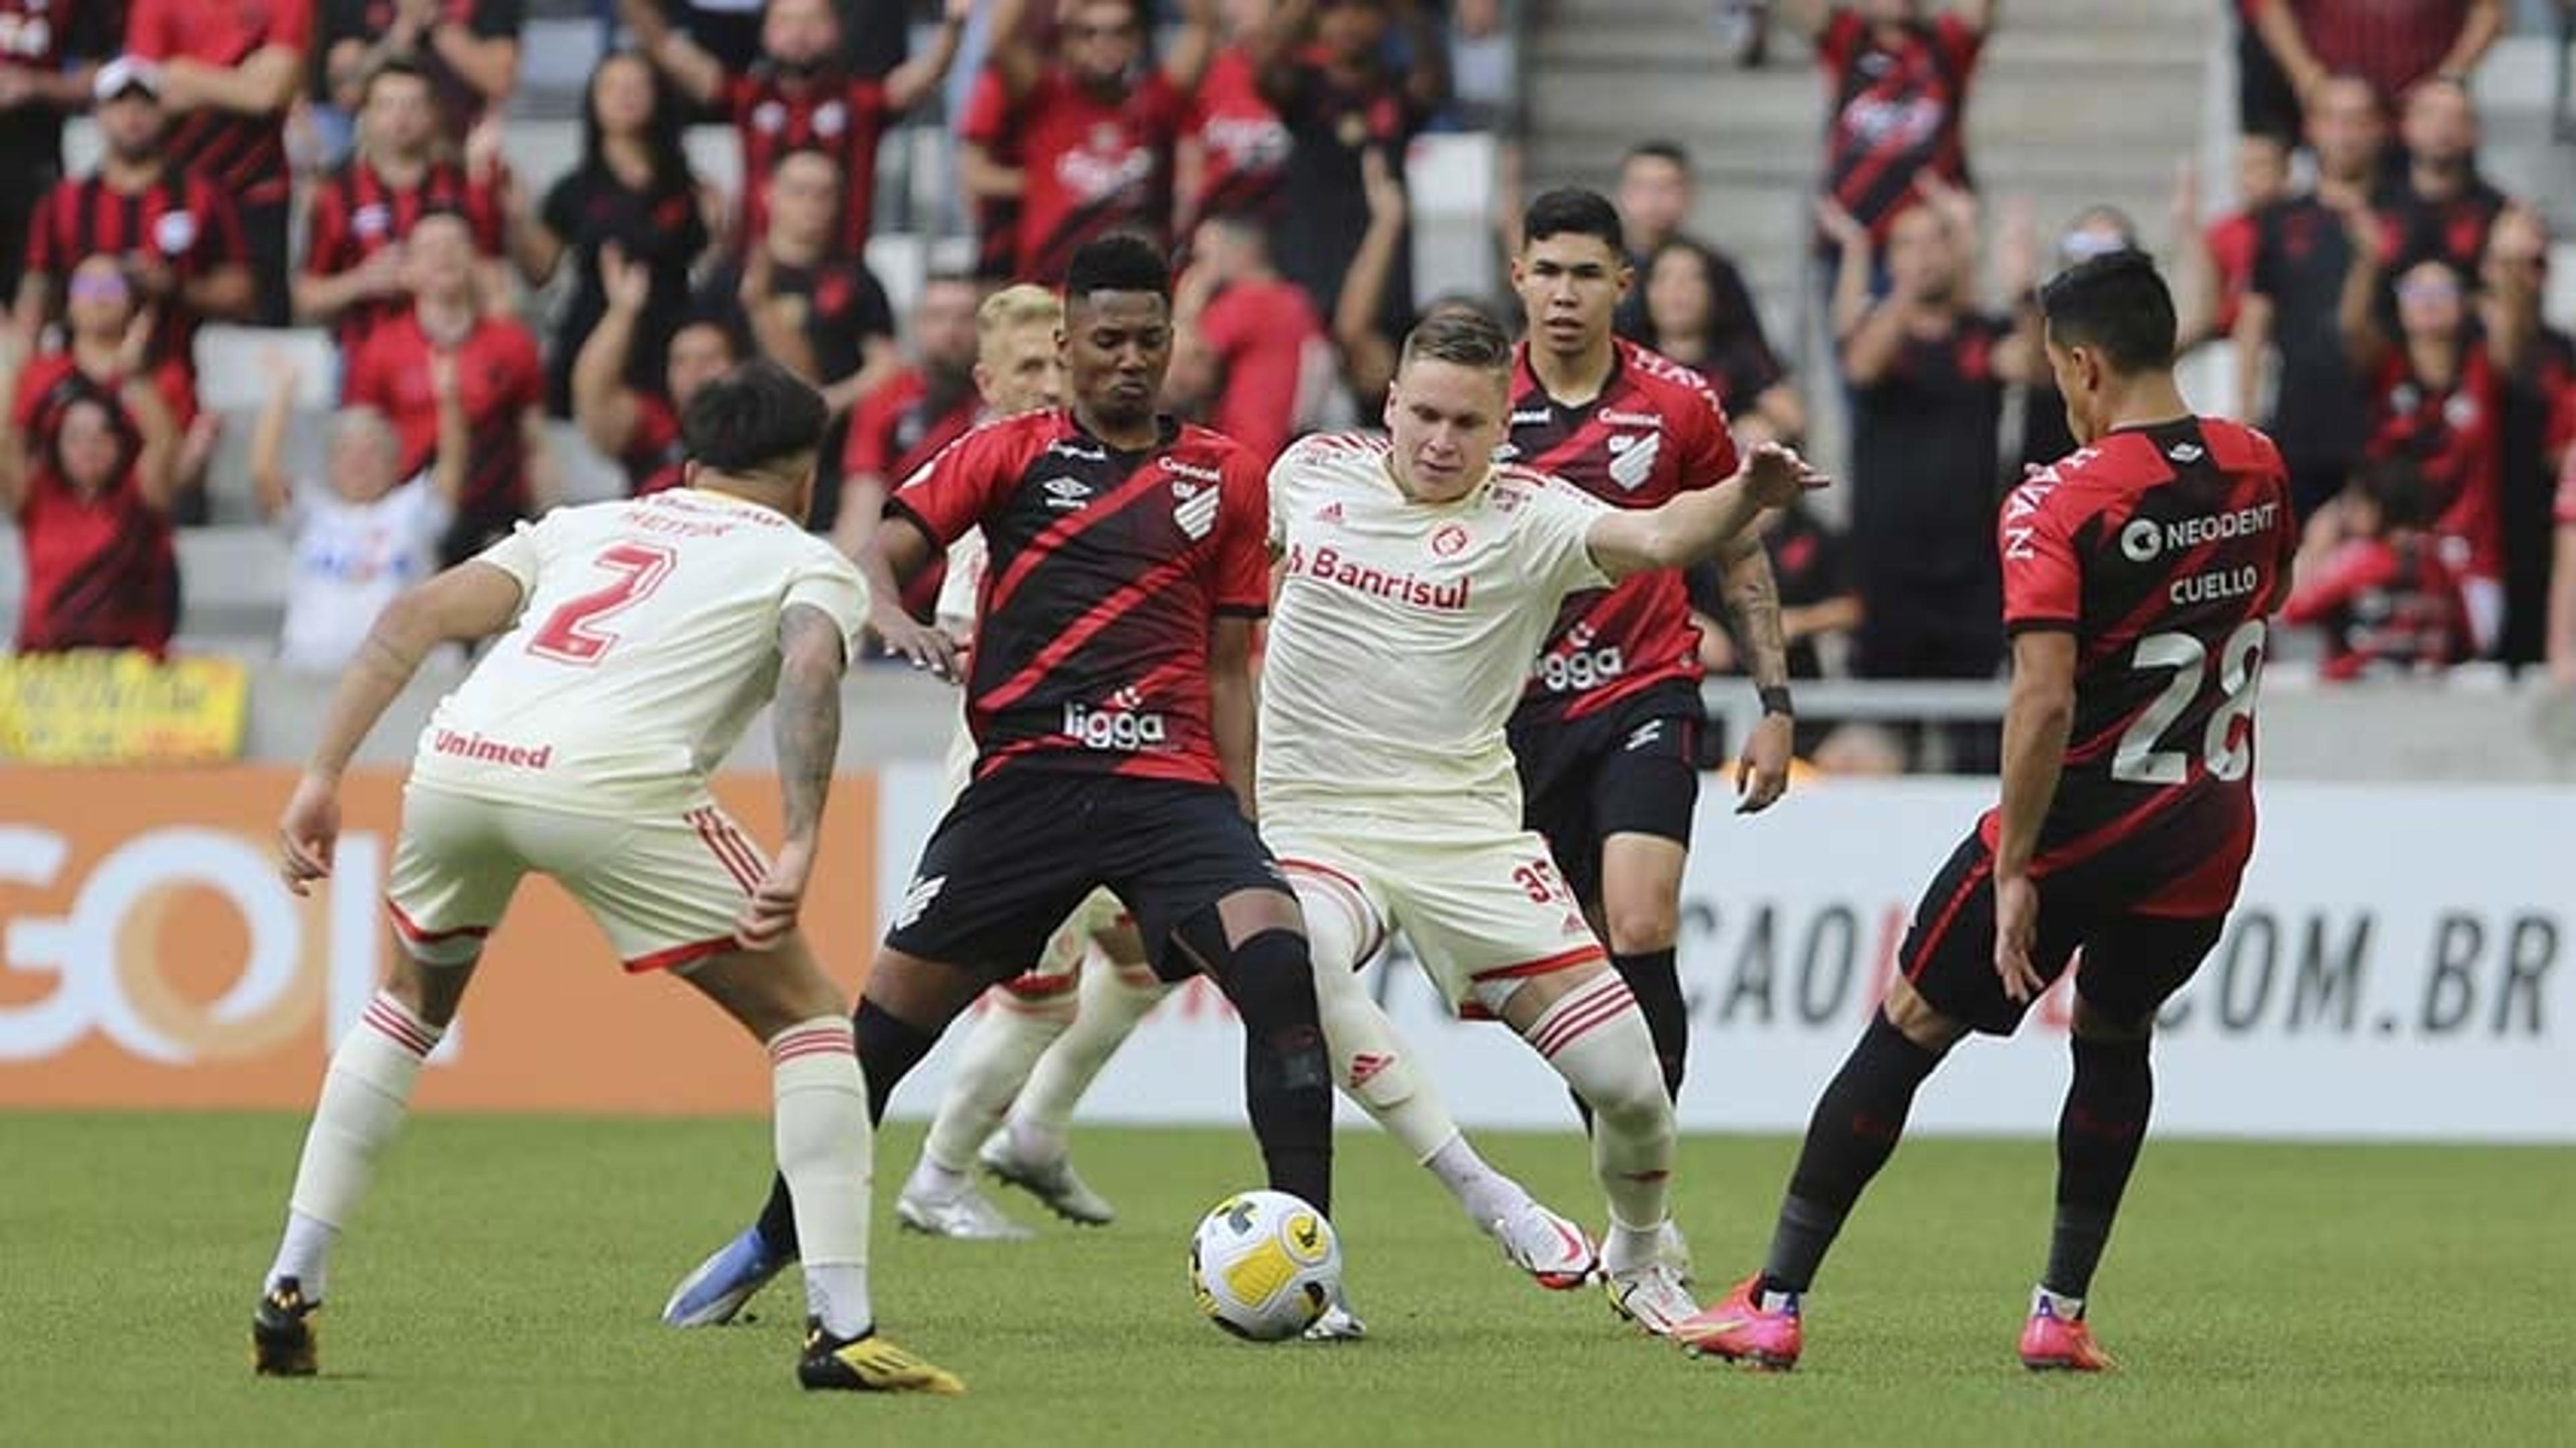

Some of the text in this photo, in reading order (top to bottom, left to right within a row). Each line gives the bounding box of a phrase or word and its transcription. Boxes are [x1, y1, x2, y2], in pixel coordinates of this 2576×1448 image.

[2166, 502, 2280, 550] NEODENT
[1311, 546, 1470, 609] Banrisul
[2169, 565, 2257, 604] CUELLO
[527, 540, 676, 666] 2
[1063, 701, 1165, 751] ligga
[2112, 618, 2266, 784] 28
[435, 729, 552, 769] Unimed
